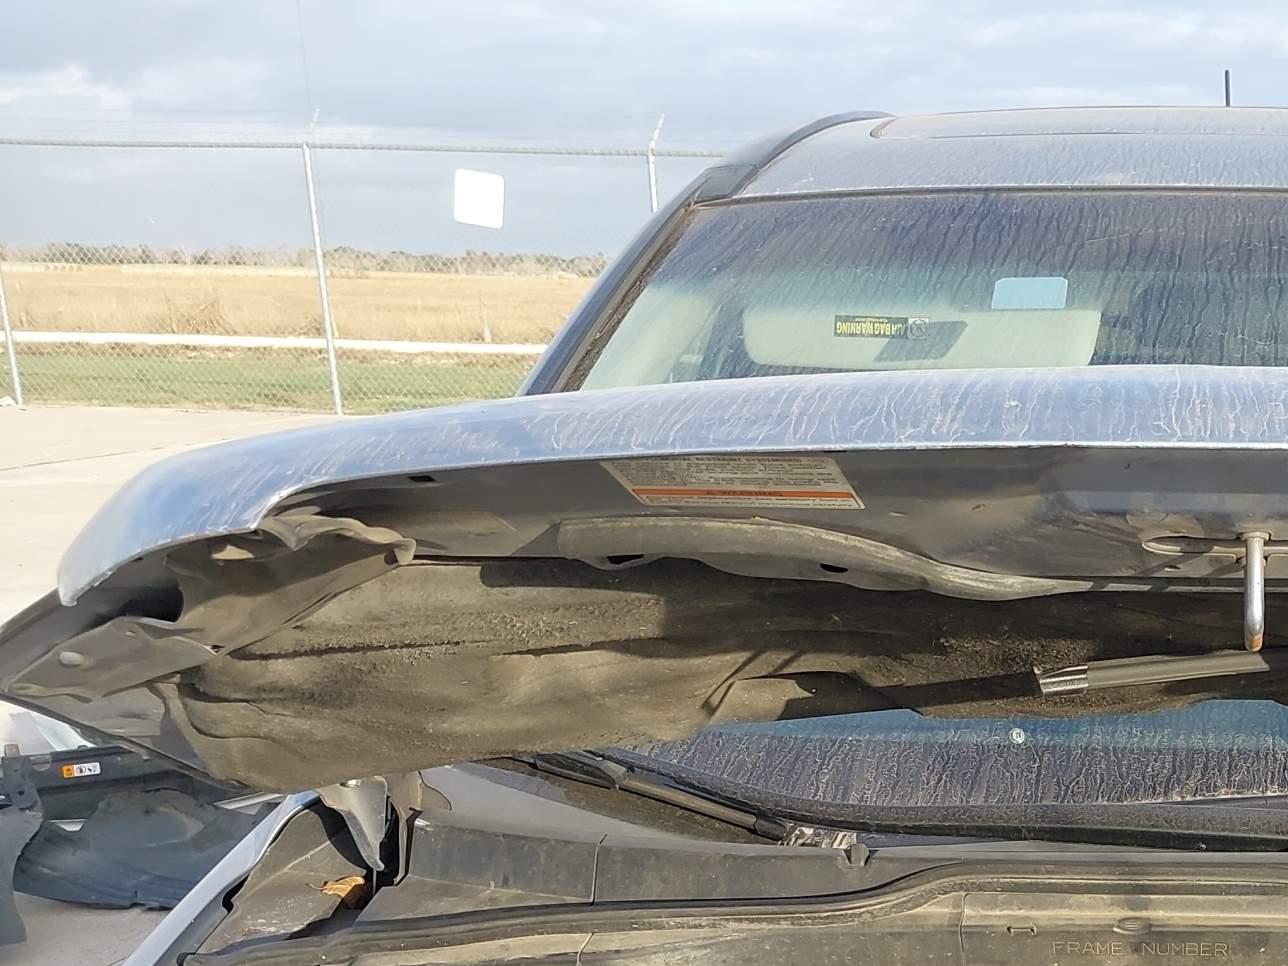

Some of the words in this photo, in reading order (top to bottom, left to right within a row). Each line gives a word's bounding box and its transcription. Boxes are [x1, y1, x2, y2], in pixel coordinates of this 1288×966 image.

[836, 321, 874, 335] WARNING
[1052, 941, 1124, 956] FRAME
[1142, 942, 1229, 957] NUMBER
